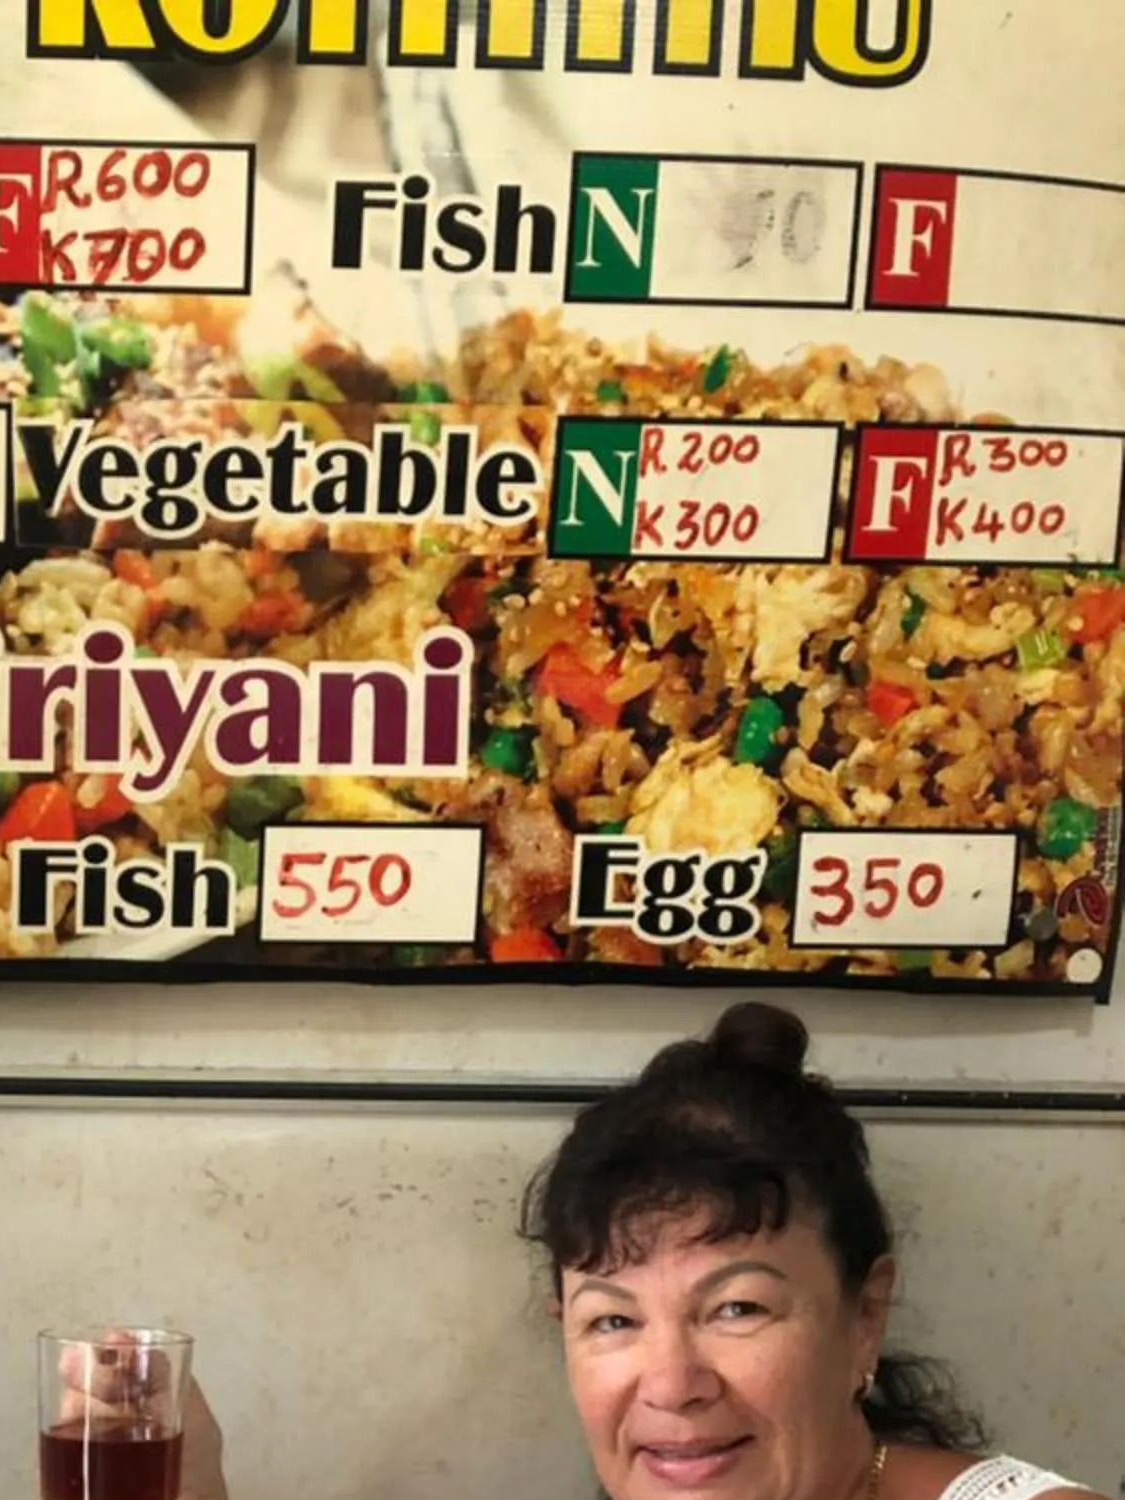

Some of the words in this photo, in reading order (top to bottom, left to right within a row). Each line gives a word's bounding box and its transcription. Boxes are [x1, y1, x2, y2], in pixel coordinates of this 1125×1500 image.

[331, 174, 557, 274] Fish
[577, 187, 656, 269] N
[883, 198, 946, 277] F
[16, 422, 538, 533] Vegetable
[560, 449, 637, 527] N
[866, 454, 929, 532] F
[16, 842, 231, 930] Fish
[271, 851, 412, 919] 550
[575, 840, 762, 940] Egg
[810, 856, 944, 927] 350
